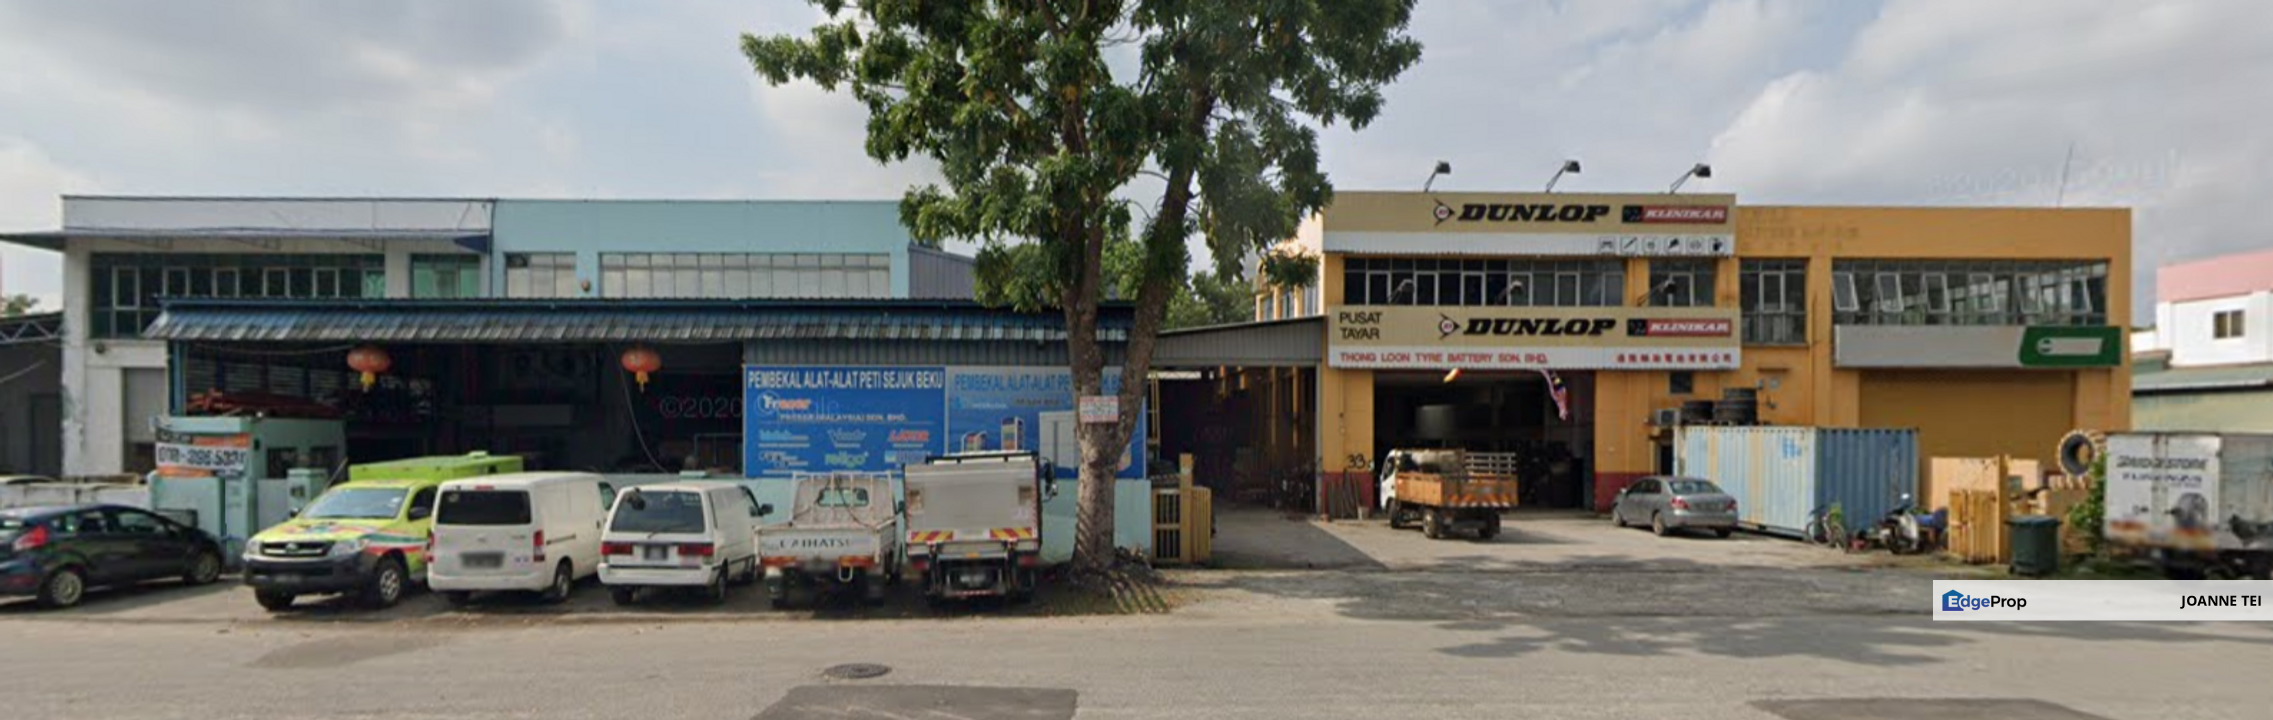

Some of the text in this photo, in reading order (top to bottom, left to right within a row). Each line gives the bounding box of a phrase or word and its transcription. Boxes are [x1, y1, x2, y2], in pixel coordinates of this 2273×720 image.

[1457, 204, 1610, 222] DUNLOP
[1645, 209, 1726, 220] KLINIKAR
[1339, 312, 1382, 324] PUSAT
[1340, 327, 1380, 340] TAYAR
[1463, 318, 1617, 336] DUNLOP
[1649, 323, 1729, 333] KLINIKAR
[1340, 353, 1377, 363] THONG
[1381, 353, 1410, 363] LOON
[1415, 353, 1443, 363] TYRE
[1447, 353, 1493, 363] BATTERY
[748, 370, 944, 388] PEMBEKAL ALAT-ALAT PETI SEJUK BEKU
[954, 374, 1005, 392] PEMBEKAL
